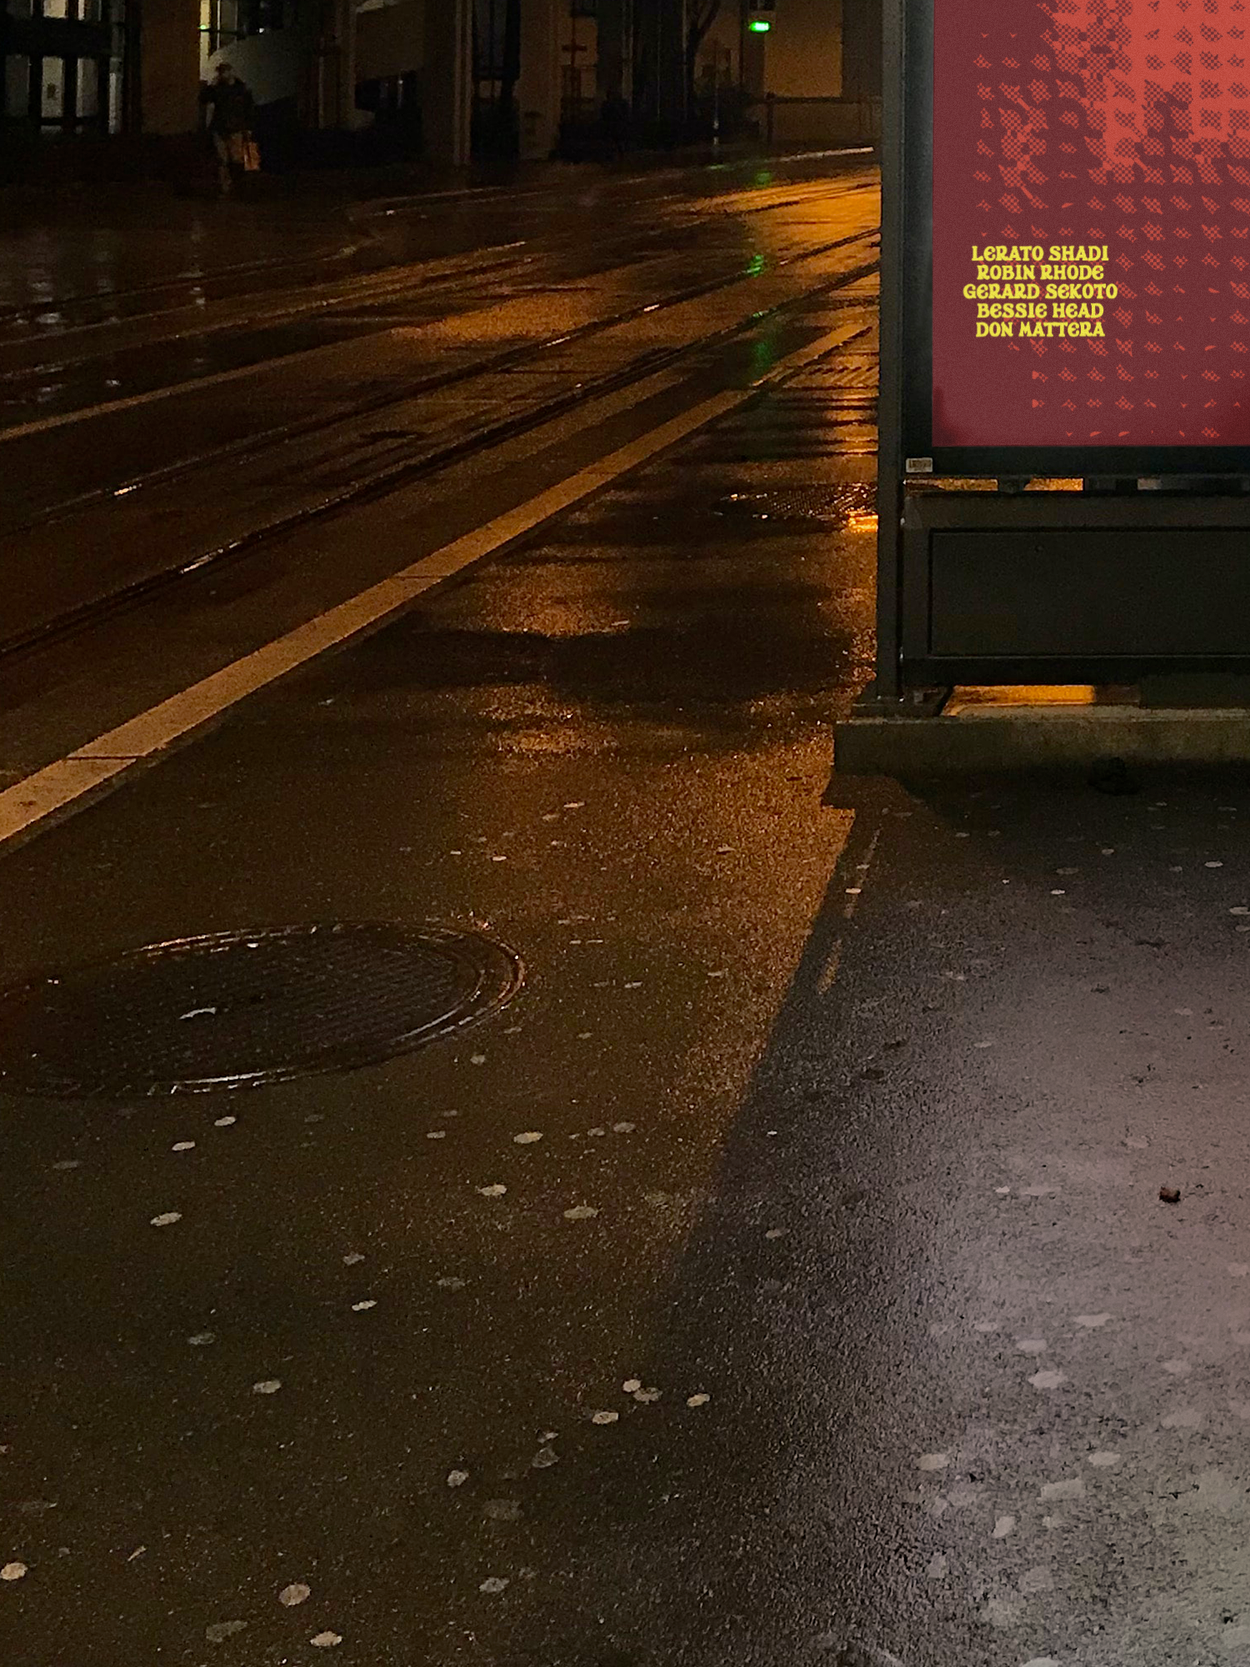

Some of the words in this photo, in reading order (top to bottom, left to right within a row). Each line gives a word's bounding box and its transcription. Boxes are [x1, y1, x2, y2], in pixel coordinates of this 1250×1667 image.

[971, 245, 1045, 262] LERATO
[1048, 245, 1110, 262] SHADI
[976, 264, 1036, 281] ROBIN
[1039, 264, 1105, 281] RHODE
[962, 283, 1041, 300] GERARD
[1044, 283, 1118, 300] SEKOTO
[976, 302, 1048, 319] BESSIE
[1051, 302, 1105, 319] HEAD
[975, 321, 1014, 338] DON
[1018, 321, 1106, 338] MATTERA
